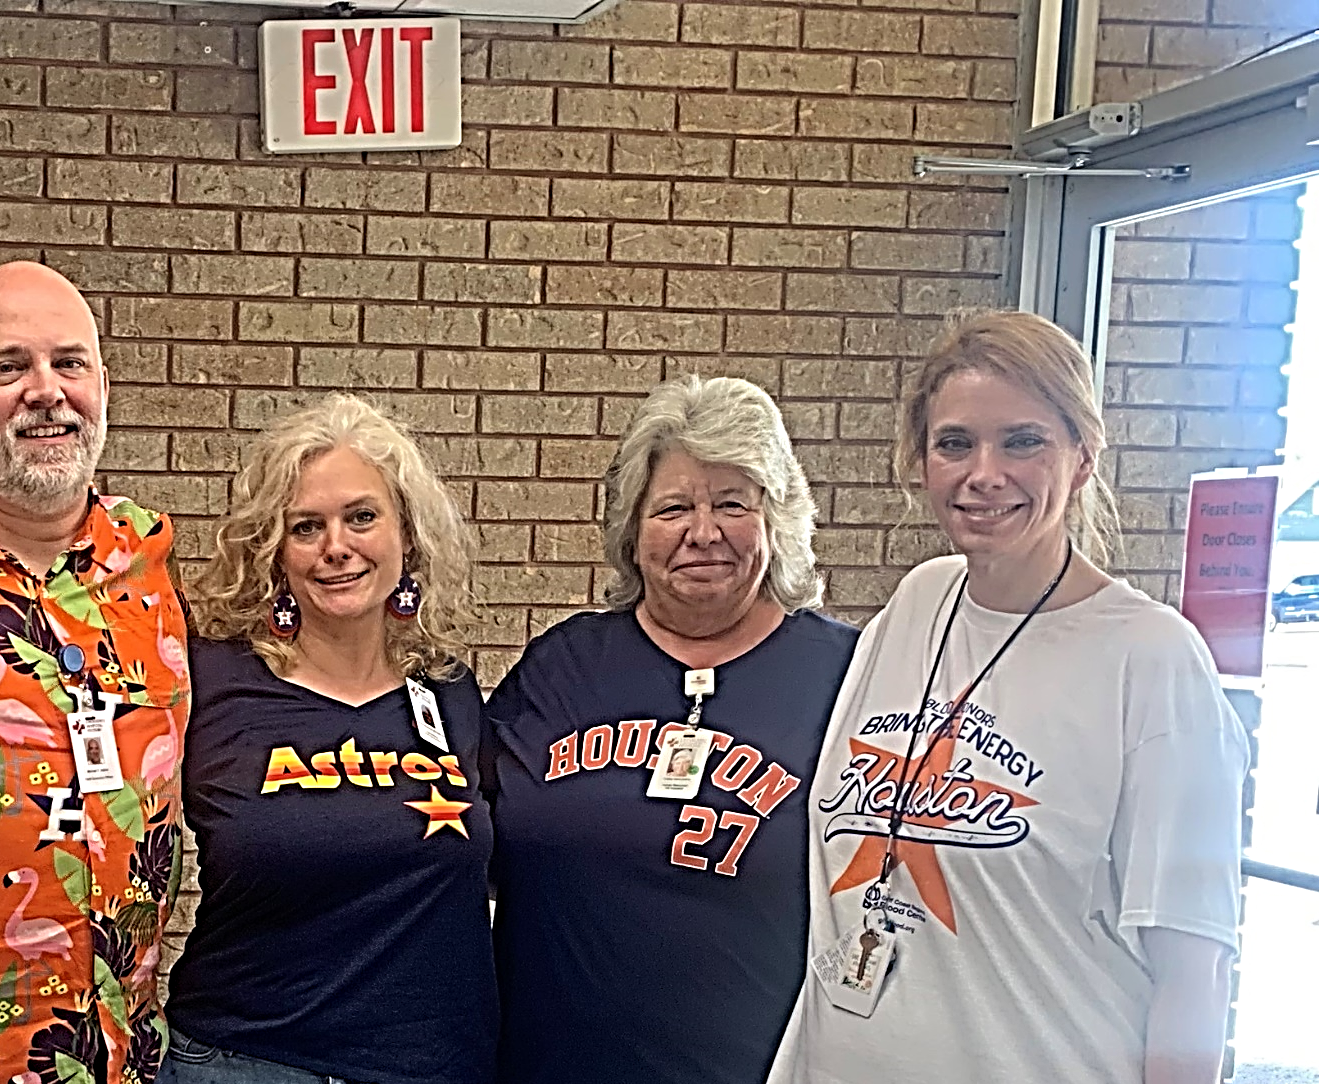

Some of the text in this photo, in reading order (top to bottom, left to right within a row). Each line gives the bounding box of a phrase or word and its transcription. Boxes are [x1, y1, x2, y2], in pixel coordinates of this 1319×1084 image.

[302, 26, 434, 136] EXIT
[1202, 532, 1257, 547] Door Closes
[260, 736, 468, 795] Astros
[956, 717, 1044, 788] ENERGY
[670, 804, 761, 877] 27
